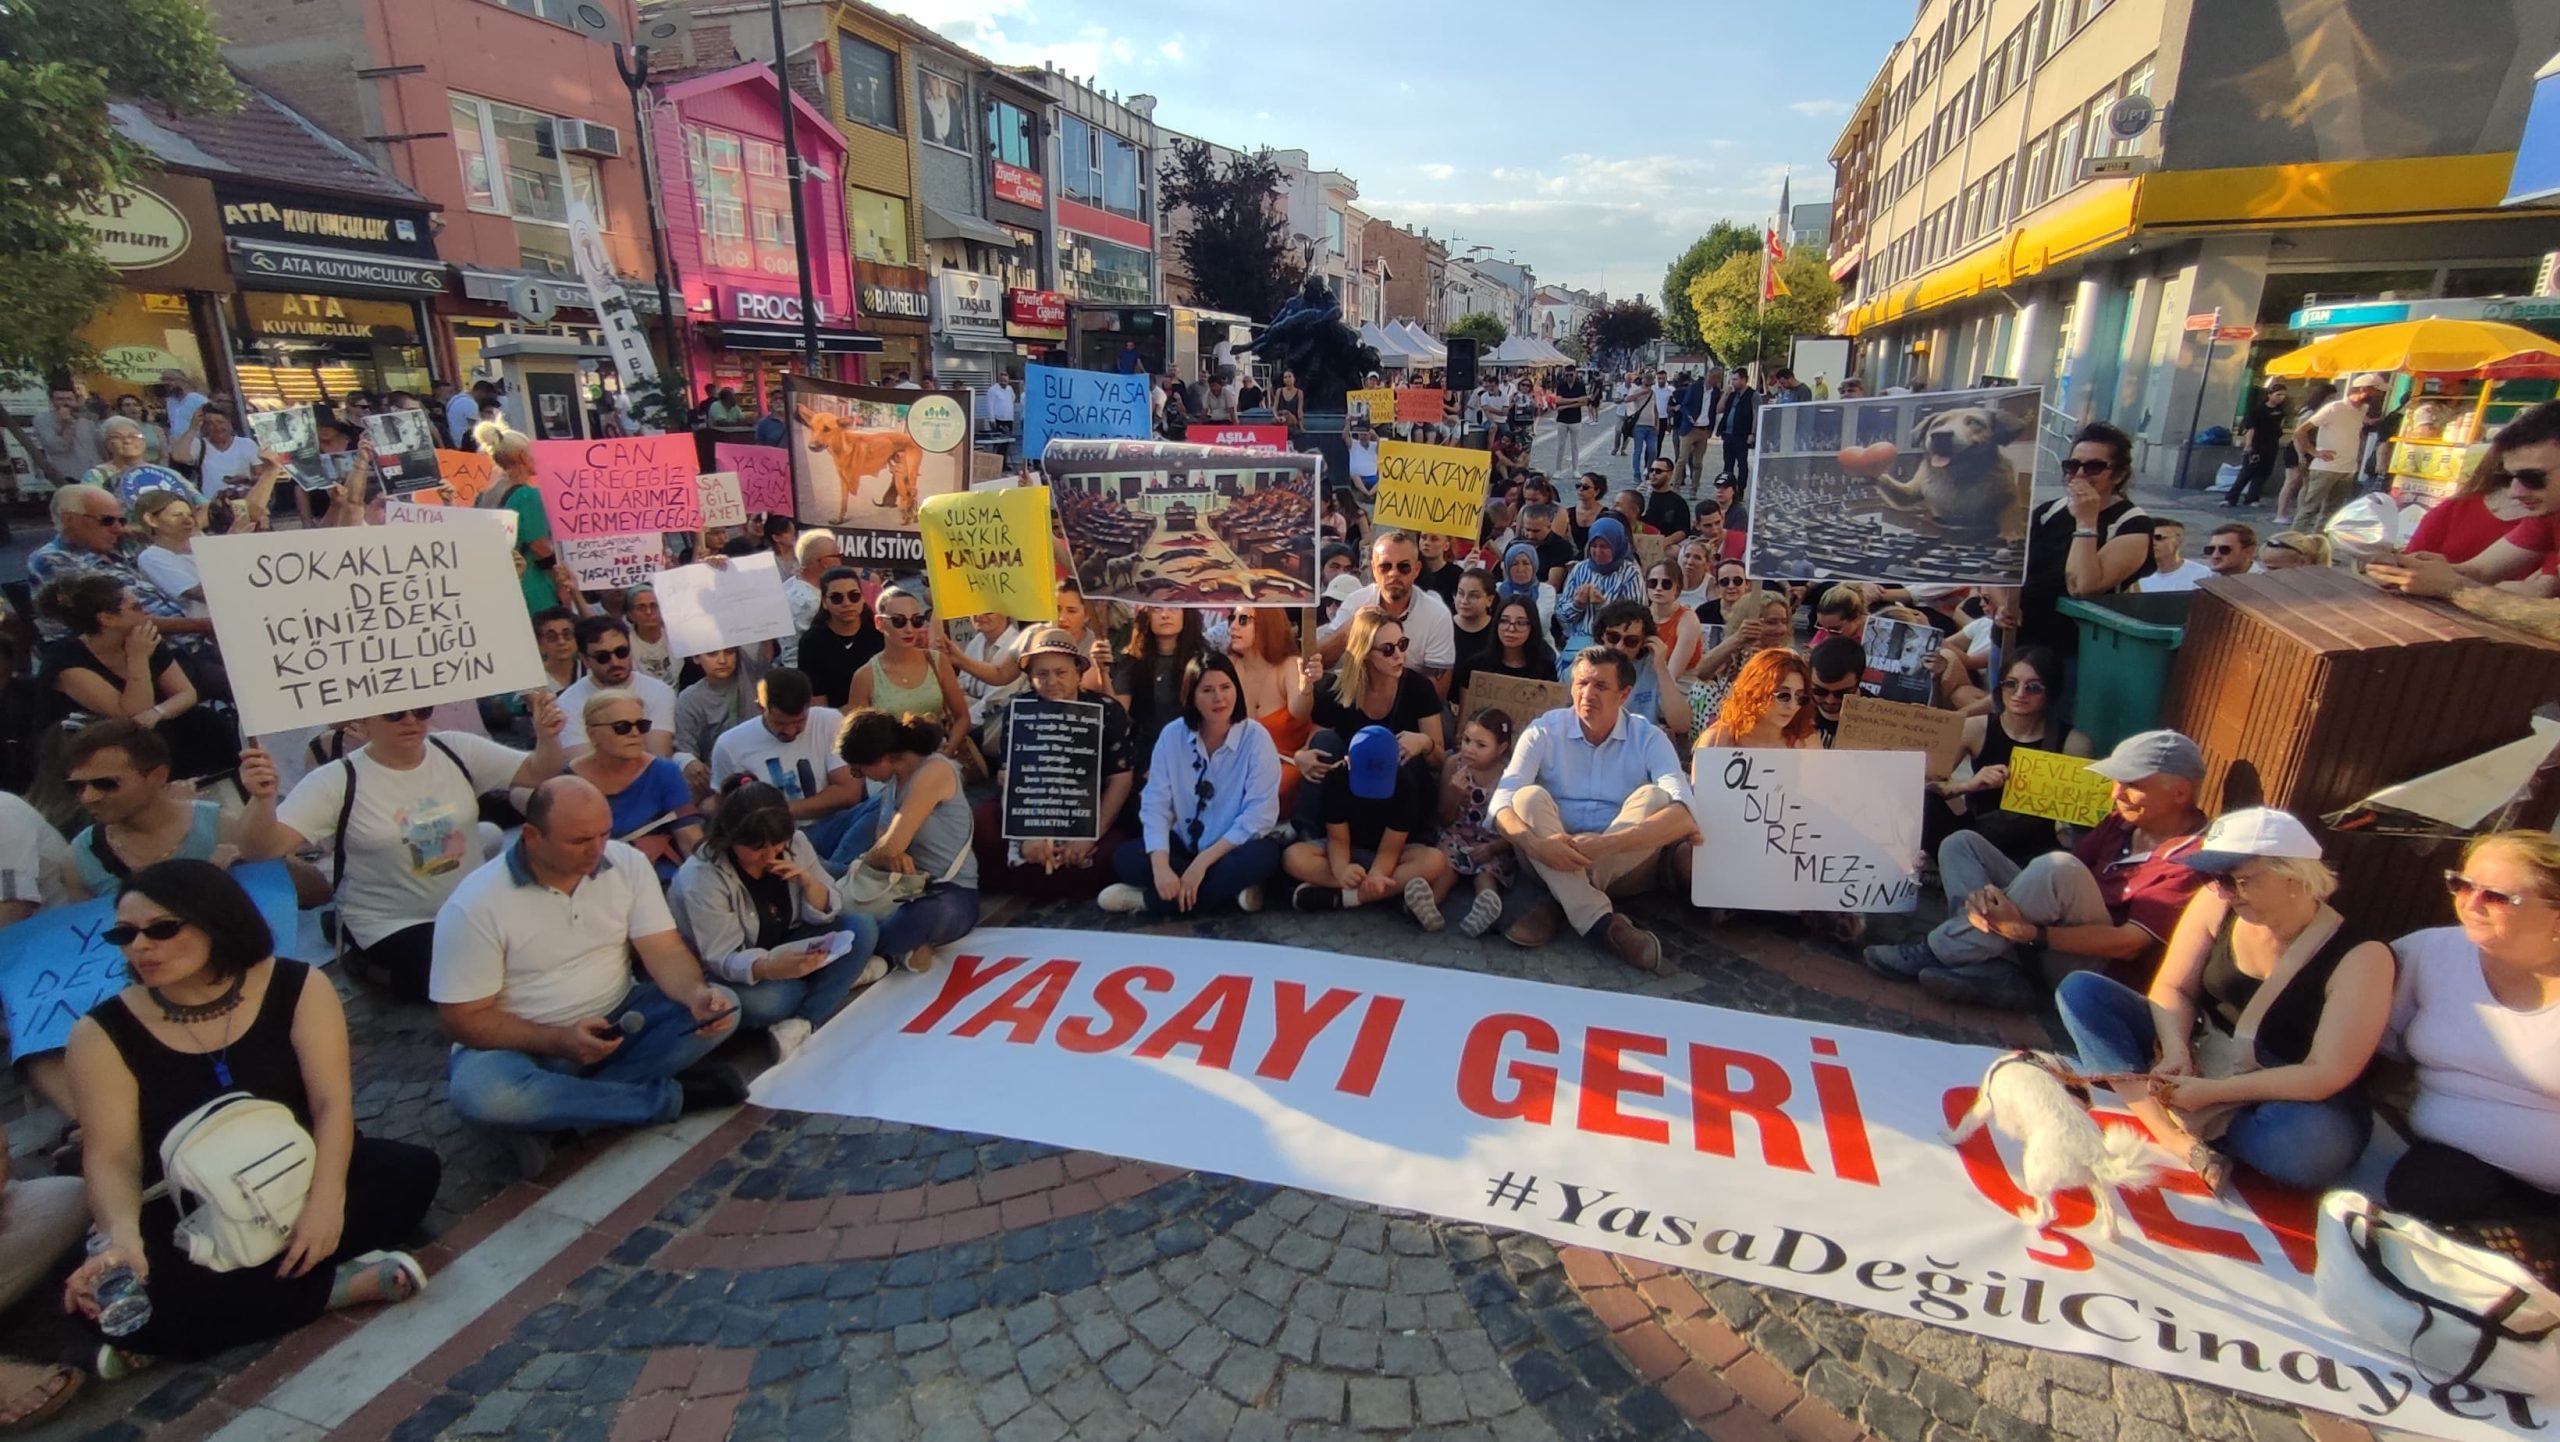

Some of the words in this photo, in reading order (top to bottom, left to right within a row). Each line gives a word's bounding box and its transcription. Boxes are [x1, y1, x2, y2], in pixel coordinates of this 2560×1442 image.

[224, 203, 281, 225] ATA
[282, 208, 390, 242] KUYUMCULUK
[281, 257, 313, 273] ATA
[315, 260, 418, 285] KUYUMCULUK
[282, 294, 346, 318] ATA
[736, 291, 825, 323] PROCN
[875, 288, 928, 317] BARGELLO
[957, 296, 992, 315] YAŞAR
[262, 319, 373, 338] KUYUMCULUK
[1044, 375, 1074, 400] BU
[1093, 379, 1148, 404] YASA
[1045, 403, 1132, 426] SOKAKTA
[585, 442, 657, 469] CAN
[1382, 455, 1488, 495] SOKAKTAYIM
[559, 487, 691, 512] CANLARIMIZI
[1377, 489, 1483, 529] YANINDAYIM
[944, 506, 1004, 527] SUSMA
[871, 531, 925, 561] İSTİYO
[947, 524, 1014, 547] HAYKIR
[248, 541, 459, 588] SOKAKLARI
[350, 573, 462, 610] DEĞİL
[966, 571, 1017, 595] HAYIR
[263, 598, 463, 647] İÇİNİZDEKİ
[272, 620, 478, 678] KÖTÜLÜĞÜ
[279, 650, 495, 710] TEMİZLEYİN
[1723, 751, 1776, 790] ÖL-
[1743, 784, 1802, 825] DÜ-
[1765, 822, 1822, 855] RE-
[1794, 854, 1875, 884] MEZ-
[899, 954, 1406, 1098] YASAYI
[1454, 1011, 1882, 1188] GERİ
[1484, 1169, 2550, 1431] #YasaDeğilCinayet
